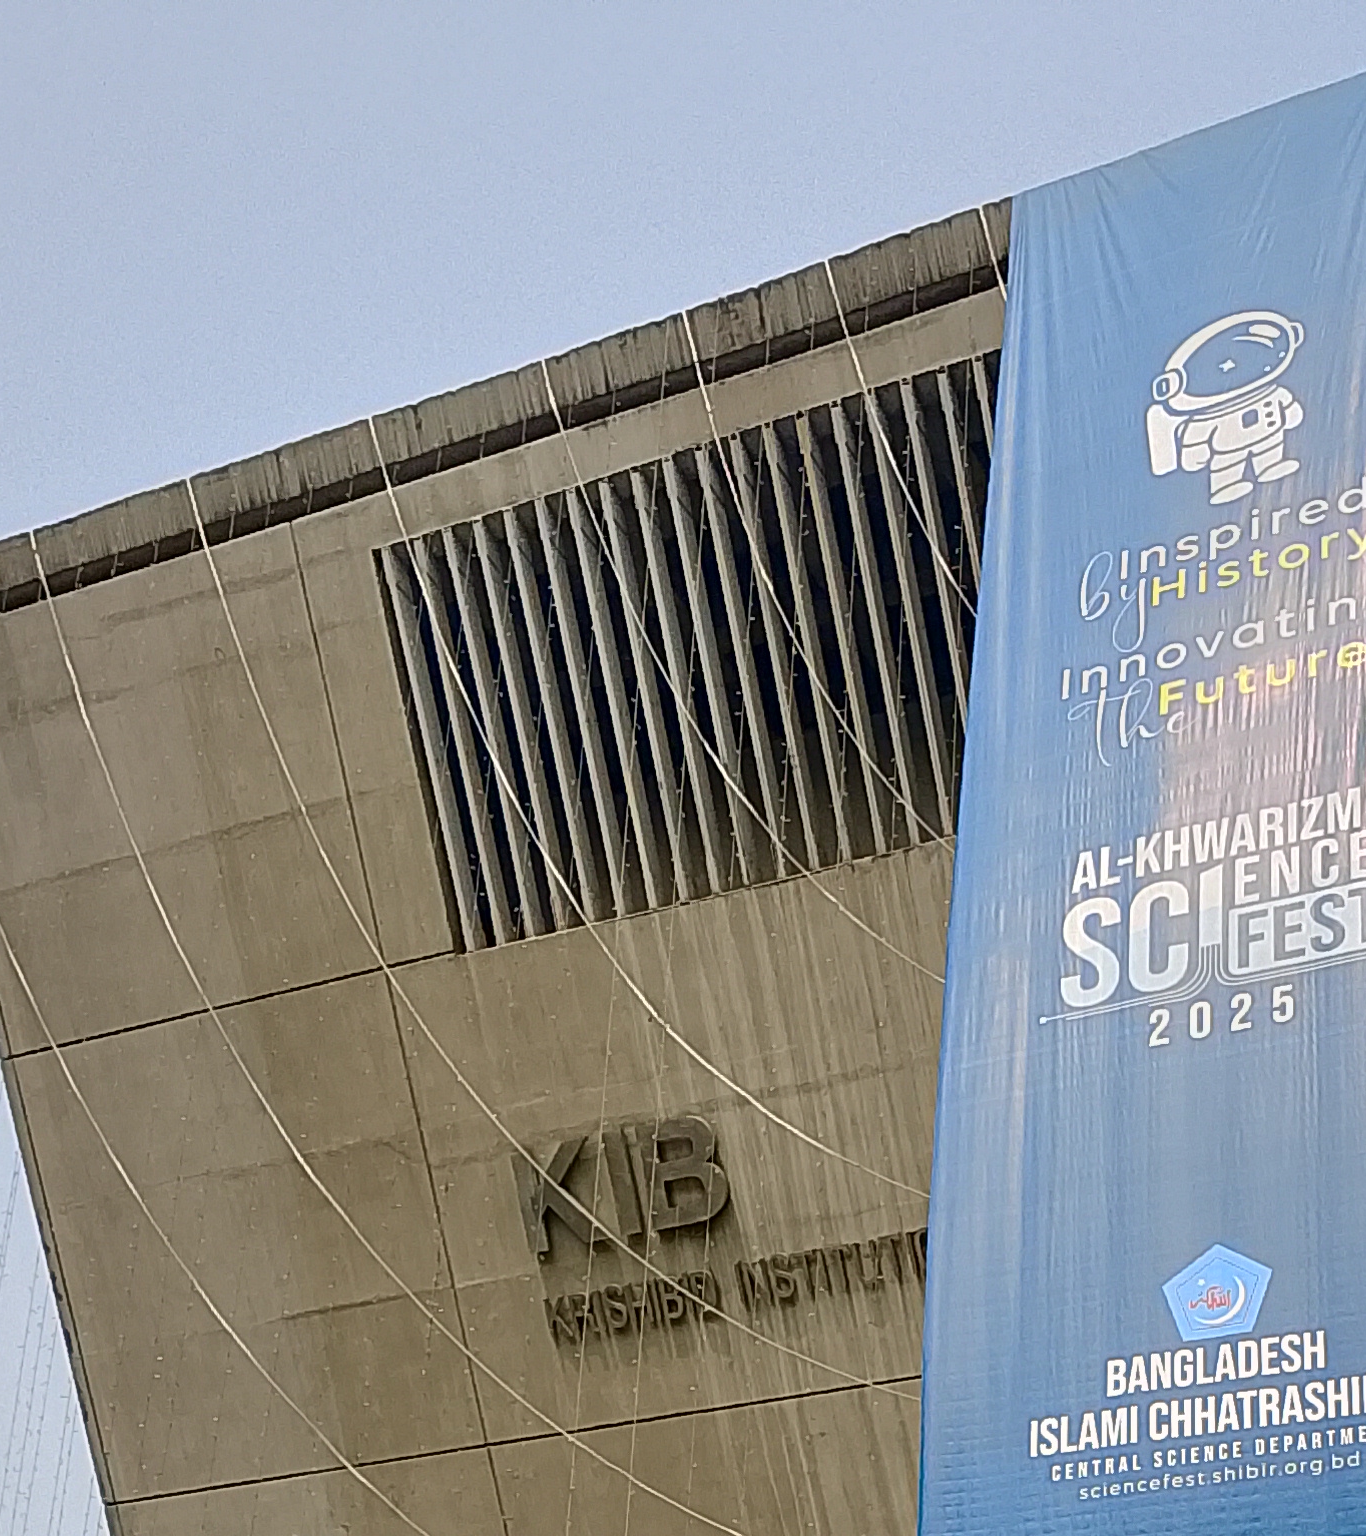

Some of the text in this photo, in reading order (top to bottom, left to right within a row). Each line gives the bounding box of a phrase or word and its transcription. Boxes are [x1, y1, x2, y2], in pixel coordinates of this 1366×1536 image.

[1080, 551, 1148, 653] by
[1148, 984, 1295, 1047] 2025
[510, 1114, 733, 1254] KIB
[1105, 1330, 1327, 1398] BANGLADESH
[1029, 1405, 1138, 1457] ISLAMI
[1051, 1454, 1142, 1482] CENTRAL
[1153, 1441, 1243, 1469] SCIENCE
[1079, 1450, 1362, 1500] sciencefest.shibir.org.bd
